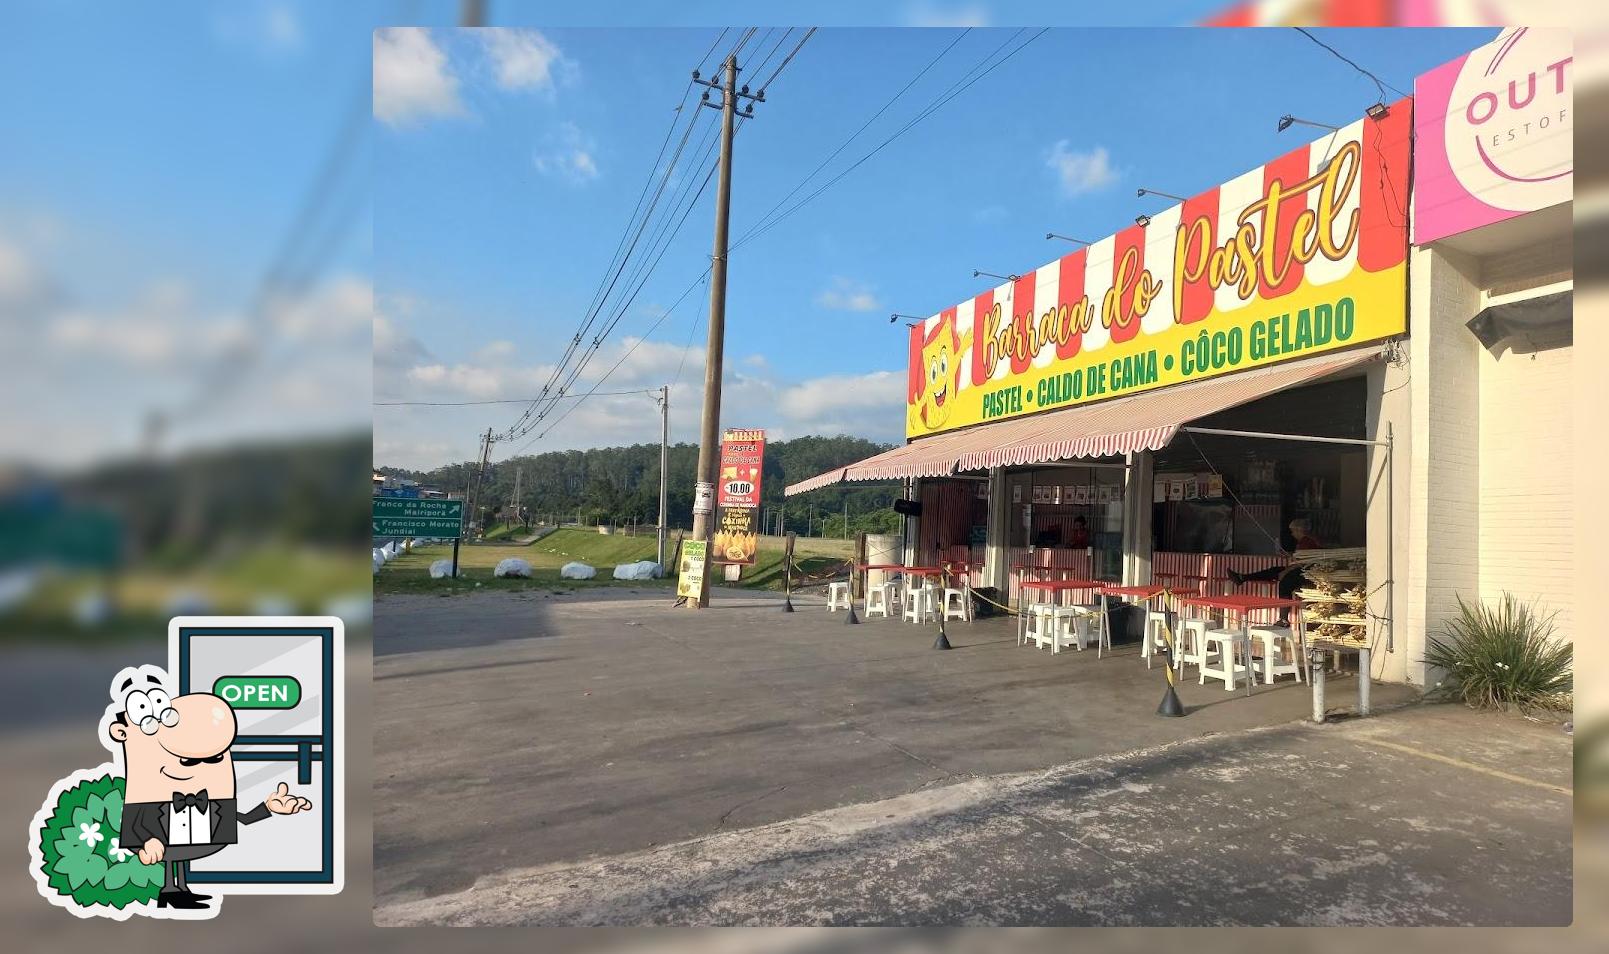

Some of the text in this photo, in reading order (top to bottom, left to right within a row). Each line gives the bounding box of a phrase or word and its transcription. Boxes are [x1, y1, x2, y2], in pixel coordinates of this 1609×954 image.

[1466, 56, 1574, 125] OUT
[1492, 109, 1567, 147] ESTOF
[981, 139, 1362, 379] Barraca do Pastel
[982, 297, 1356, 420] PASTEL CALDO DE CANA CÔCO GELADO
[382, 519, 426, 527] Francisco
